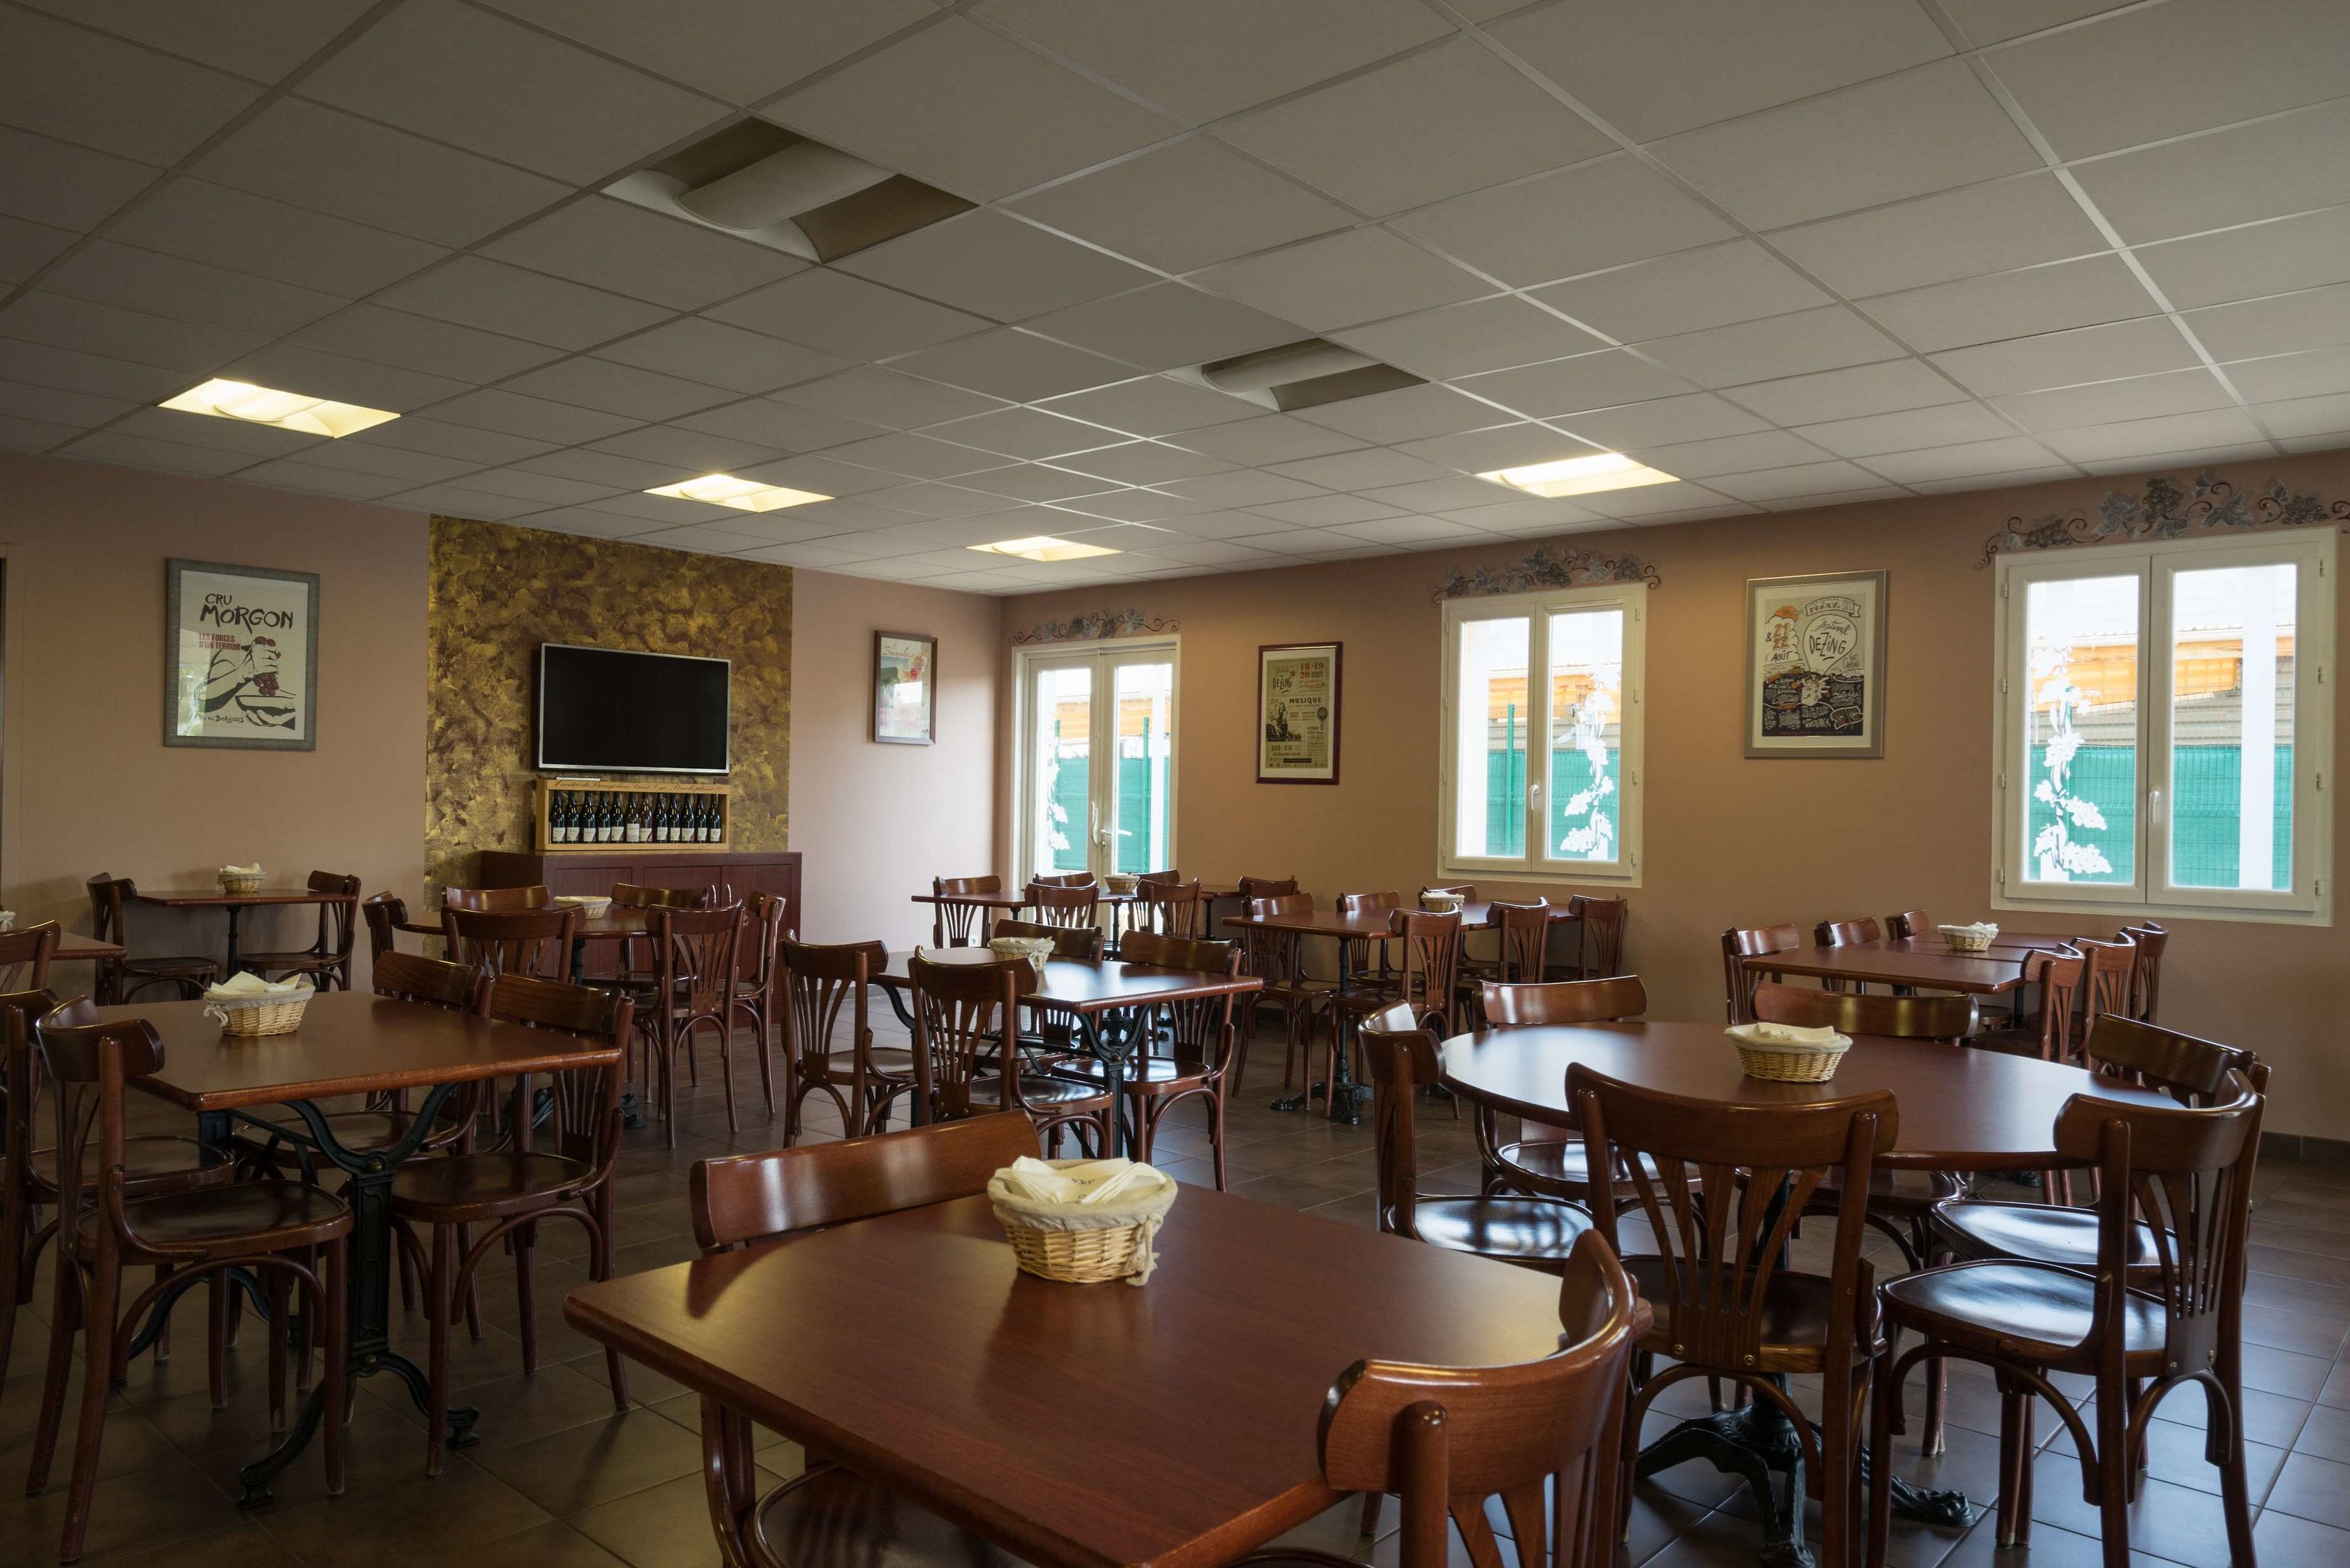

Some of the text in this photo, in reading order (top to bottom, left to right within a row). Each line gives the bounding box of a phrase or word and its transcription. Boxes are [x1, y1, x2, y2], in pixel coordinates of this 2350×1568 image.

[205, 593, 232, 608] CRU
[200, 604, 293, 635] MORGON
[212, 634, 235, 642] FORCES
[215, 642, 241, 651] TERROIR
